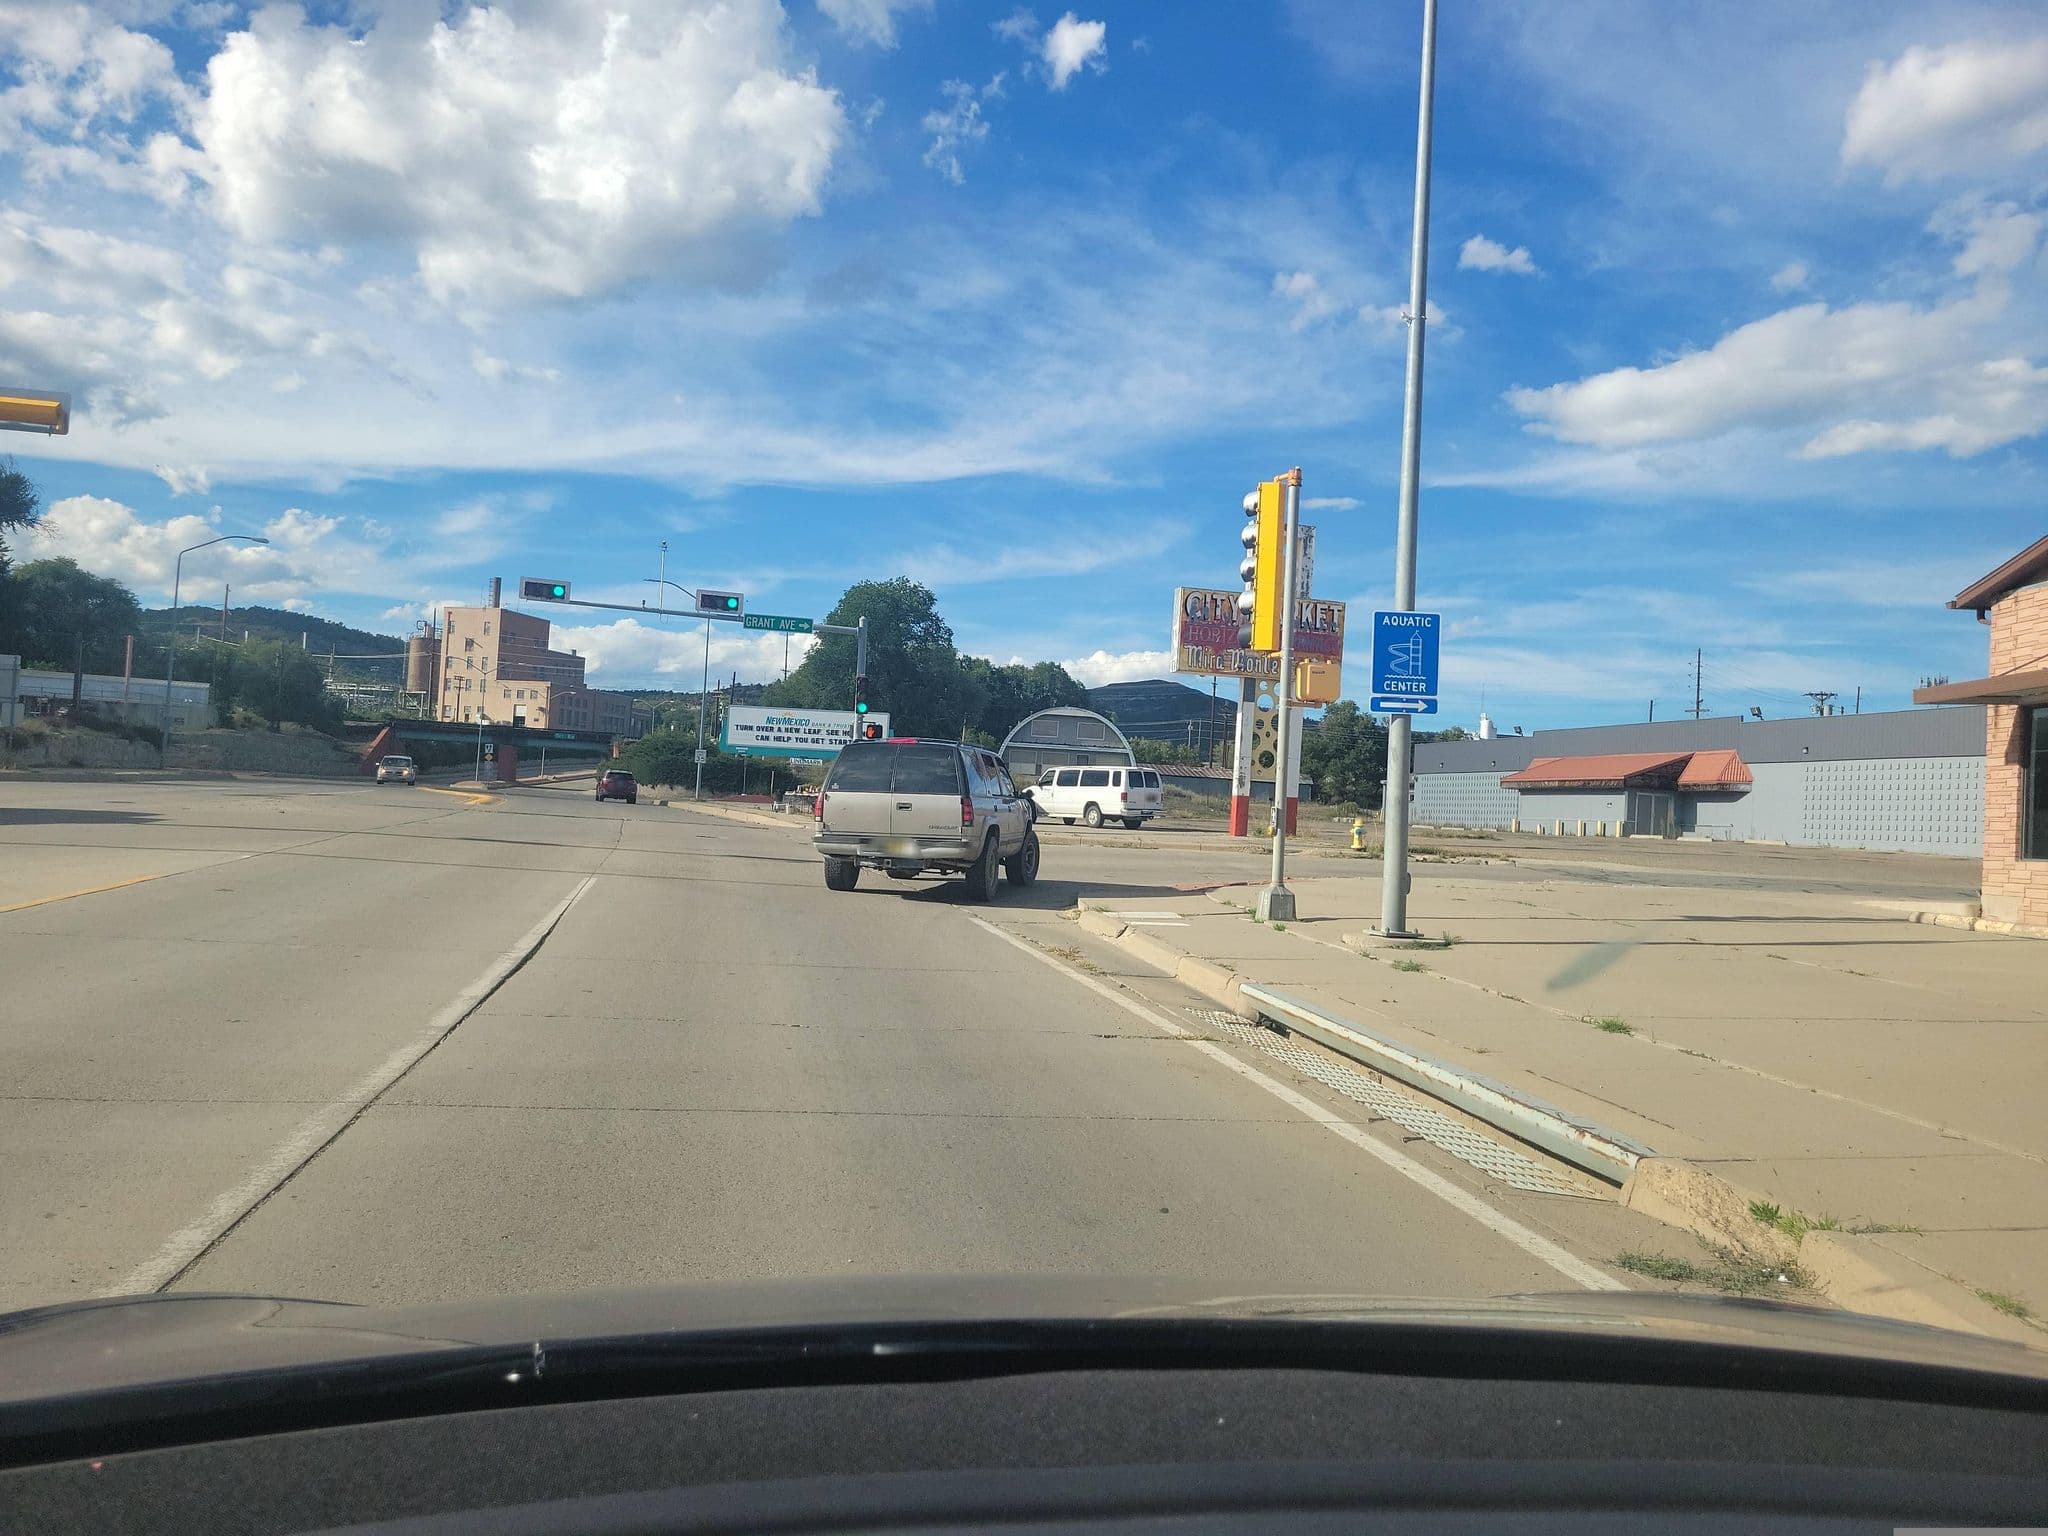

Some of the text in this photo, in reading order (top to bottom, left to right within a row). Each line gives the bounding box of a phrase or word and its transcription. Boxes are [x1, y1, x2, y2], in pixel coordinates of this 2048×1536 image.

[1185, 591, 1240, 621] CITY
[745, 616, 796, 630] GRANT AVE
[1382, 615, 1432, 627] AQUATIC
[1184, 645, 1278, 674] Mira Monte
[1383, 681, 1427, 692] CENTER
